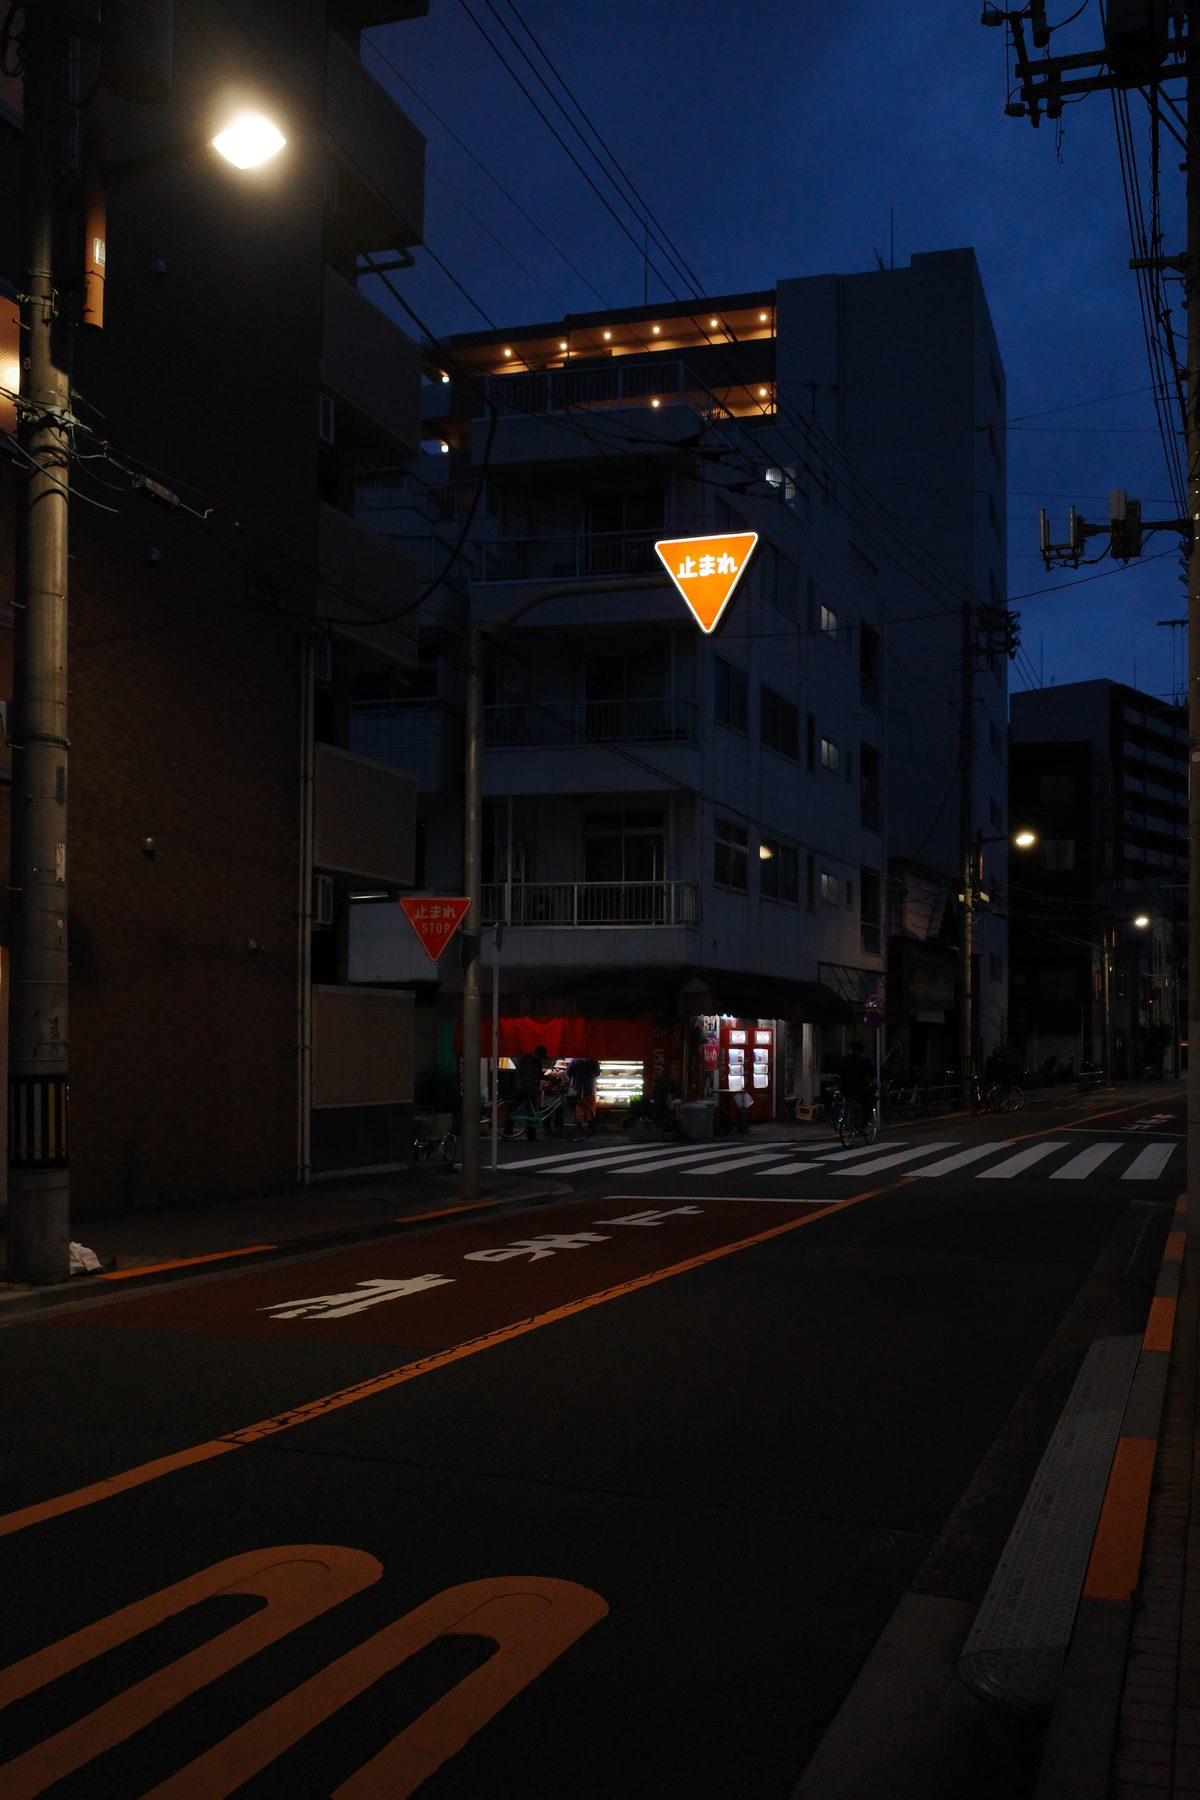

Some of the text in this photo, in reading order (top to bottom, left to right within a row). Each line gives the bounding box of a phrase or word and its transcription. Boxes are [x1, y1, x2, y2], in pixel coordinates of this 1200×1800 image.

[676, 552, 739, 579] 止まれ
[414, 904, 457, 919] 止まれ
[421, 922, 451, 935] STOP
